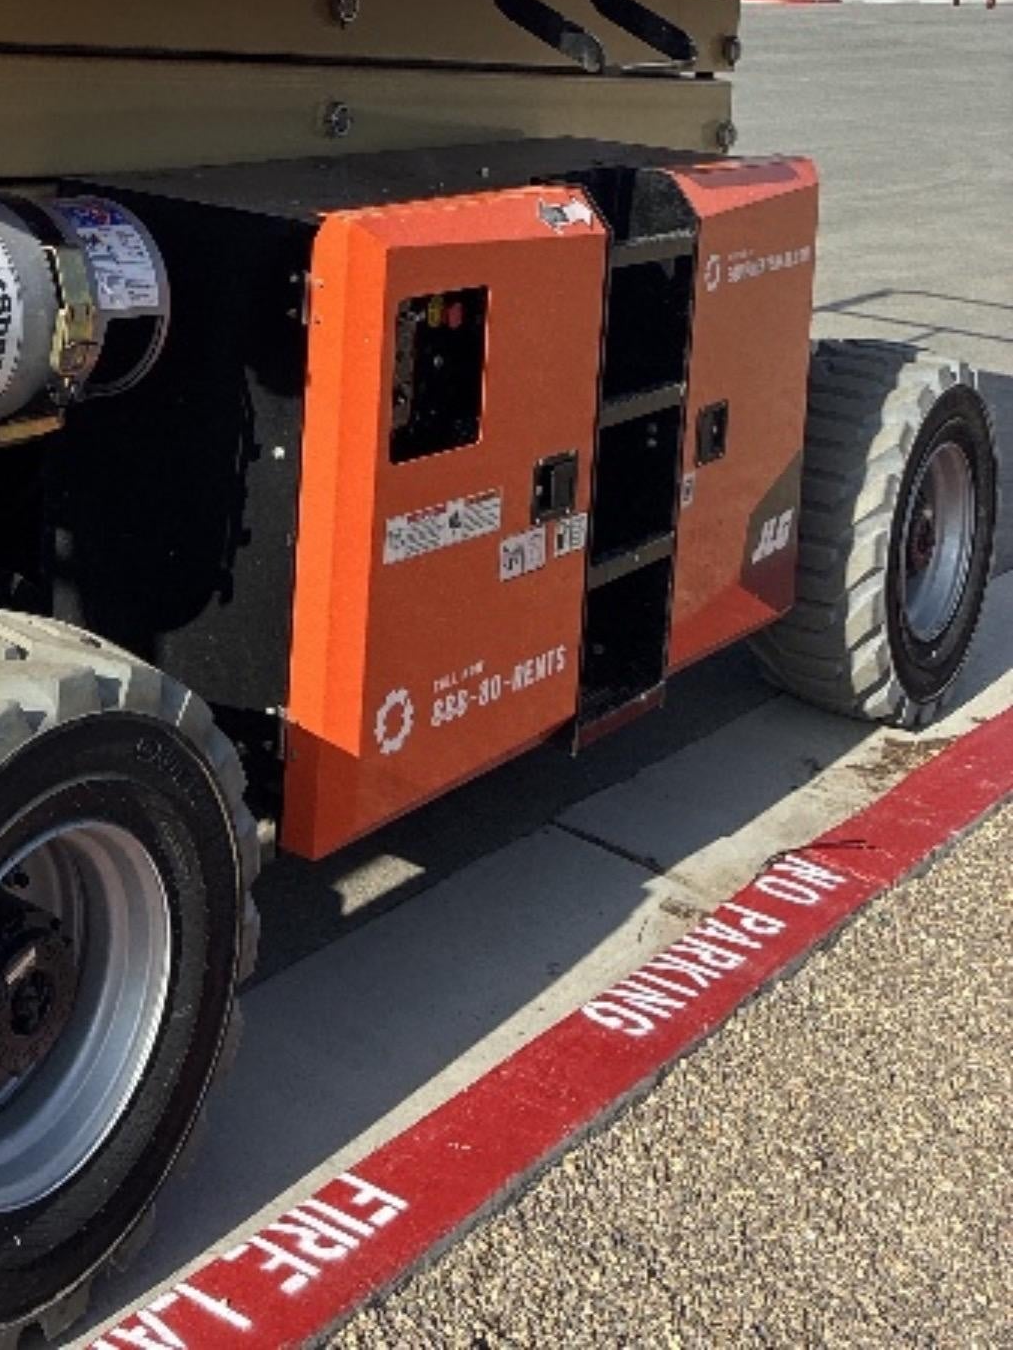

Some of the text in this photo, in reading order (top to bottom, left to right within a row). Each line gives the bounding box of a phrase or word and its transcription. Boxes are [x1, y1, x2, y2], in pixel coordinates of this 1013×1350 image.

[581, 854, 846, 1037] NO PARKING
[219, 1172, 409, 1296] FIRE
